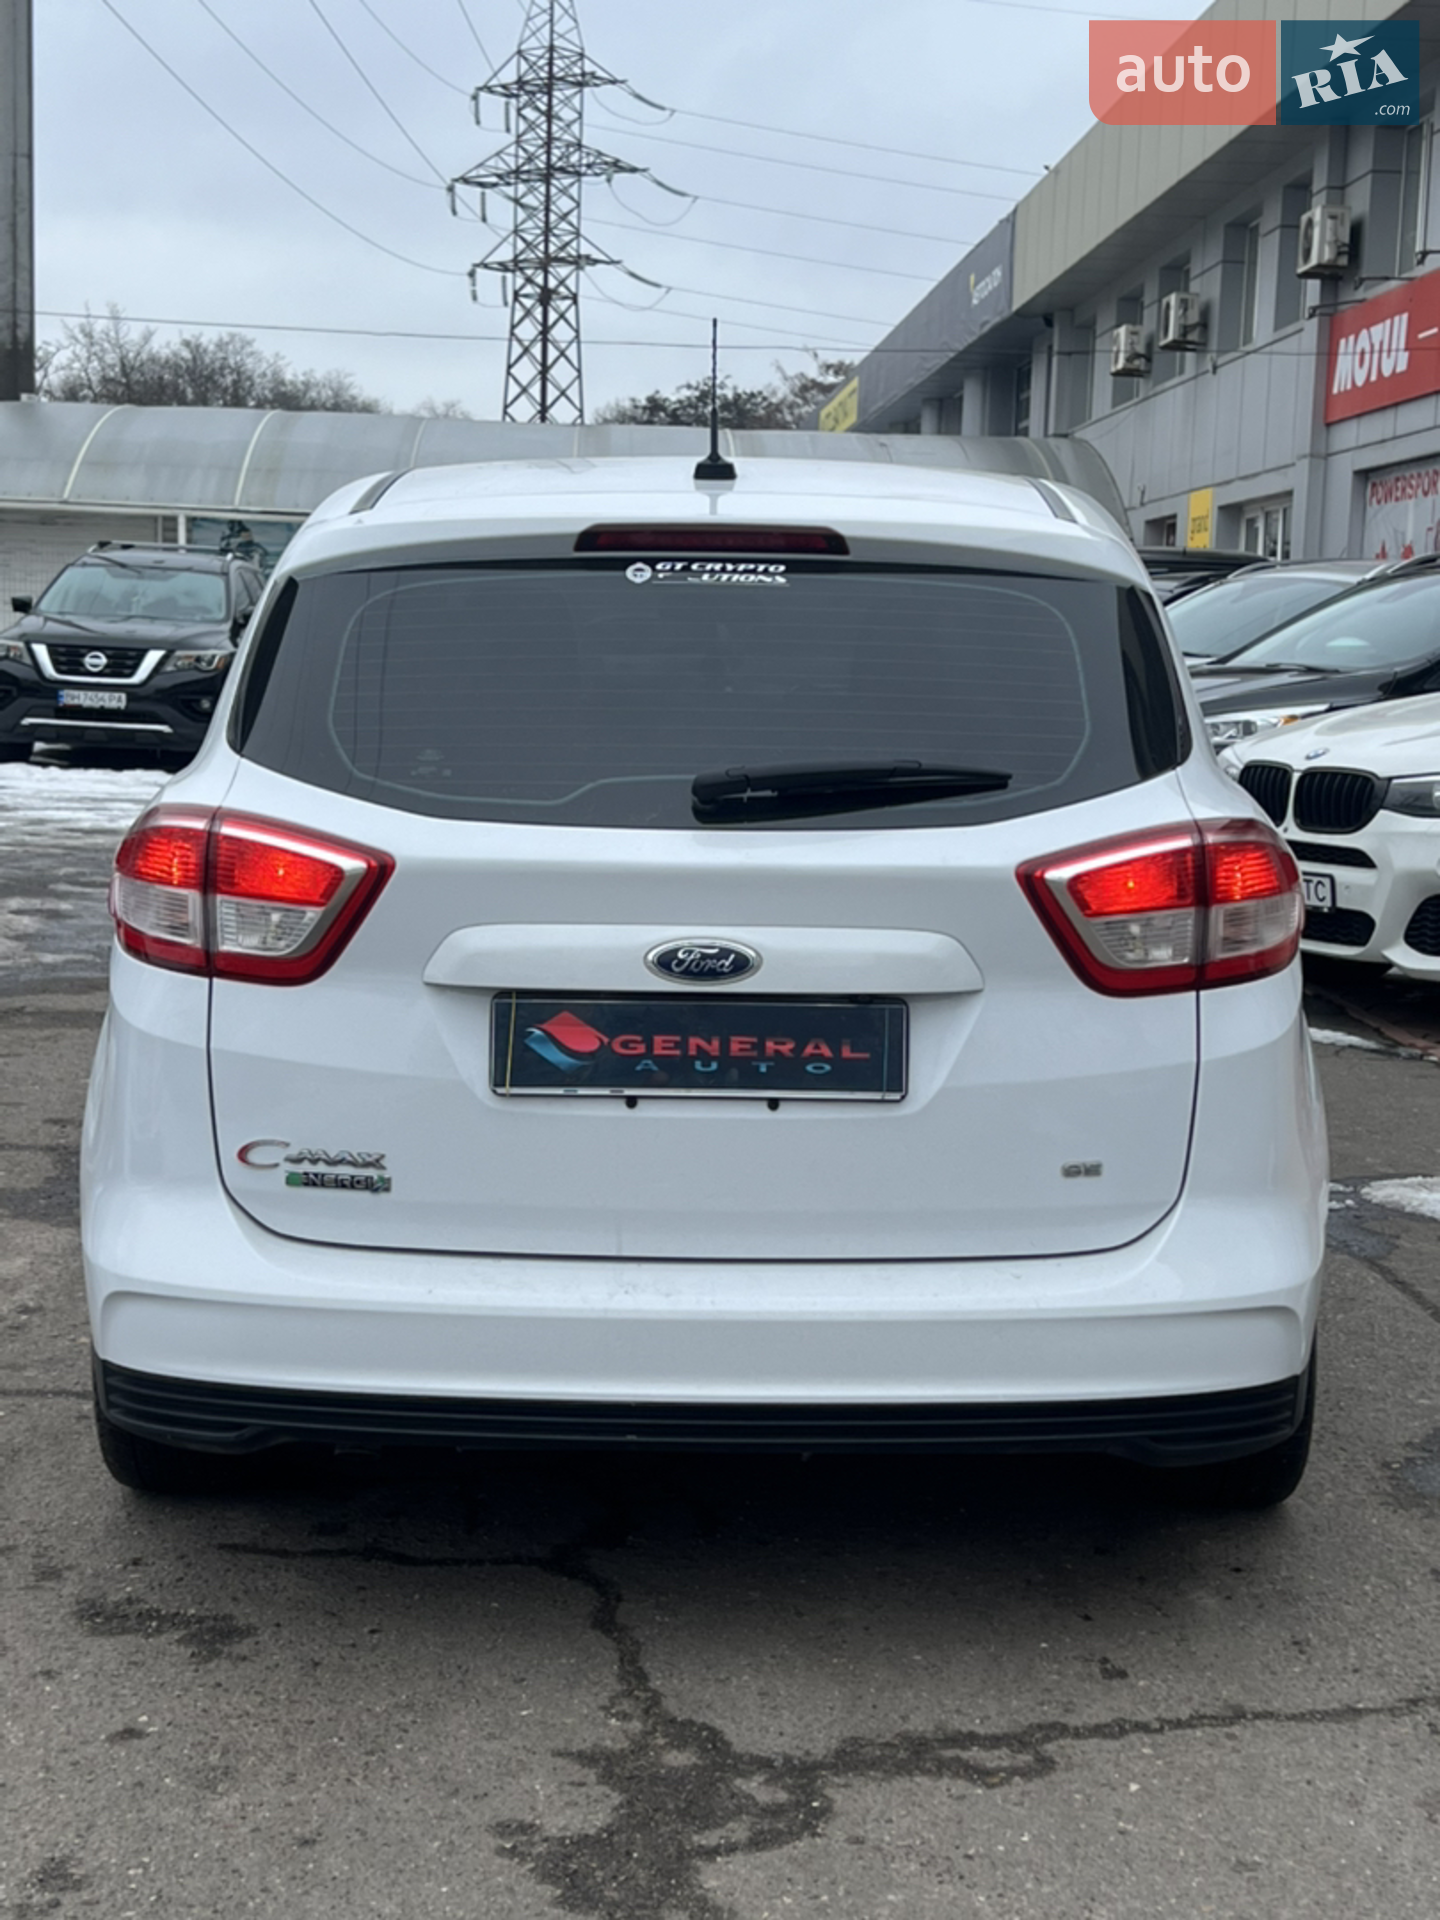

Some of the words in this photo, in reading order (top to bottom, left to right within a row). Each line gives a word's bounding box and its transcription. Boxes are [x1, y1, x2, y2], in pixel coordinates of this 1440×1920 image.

[1332, 311, 1409, 395] MOTUL
[690, 562, 786, 573] CRYPTO
[671, 947, 735, 973] Ford
[611, 1034, 871, 1059] GENERAL
[635, 1060, 832, 1074] AUTO
